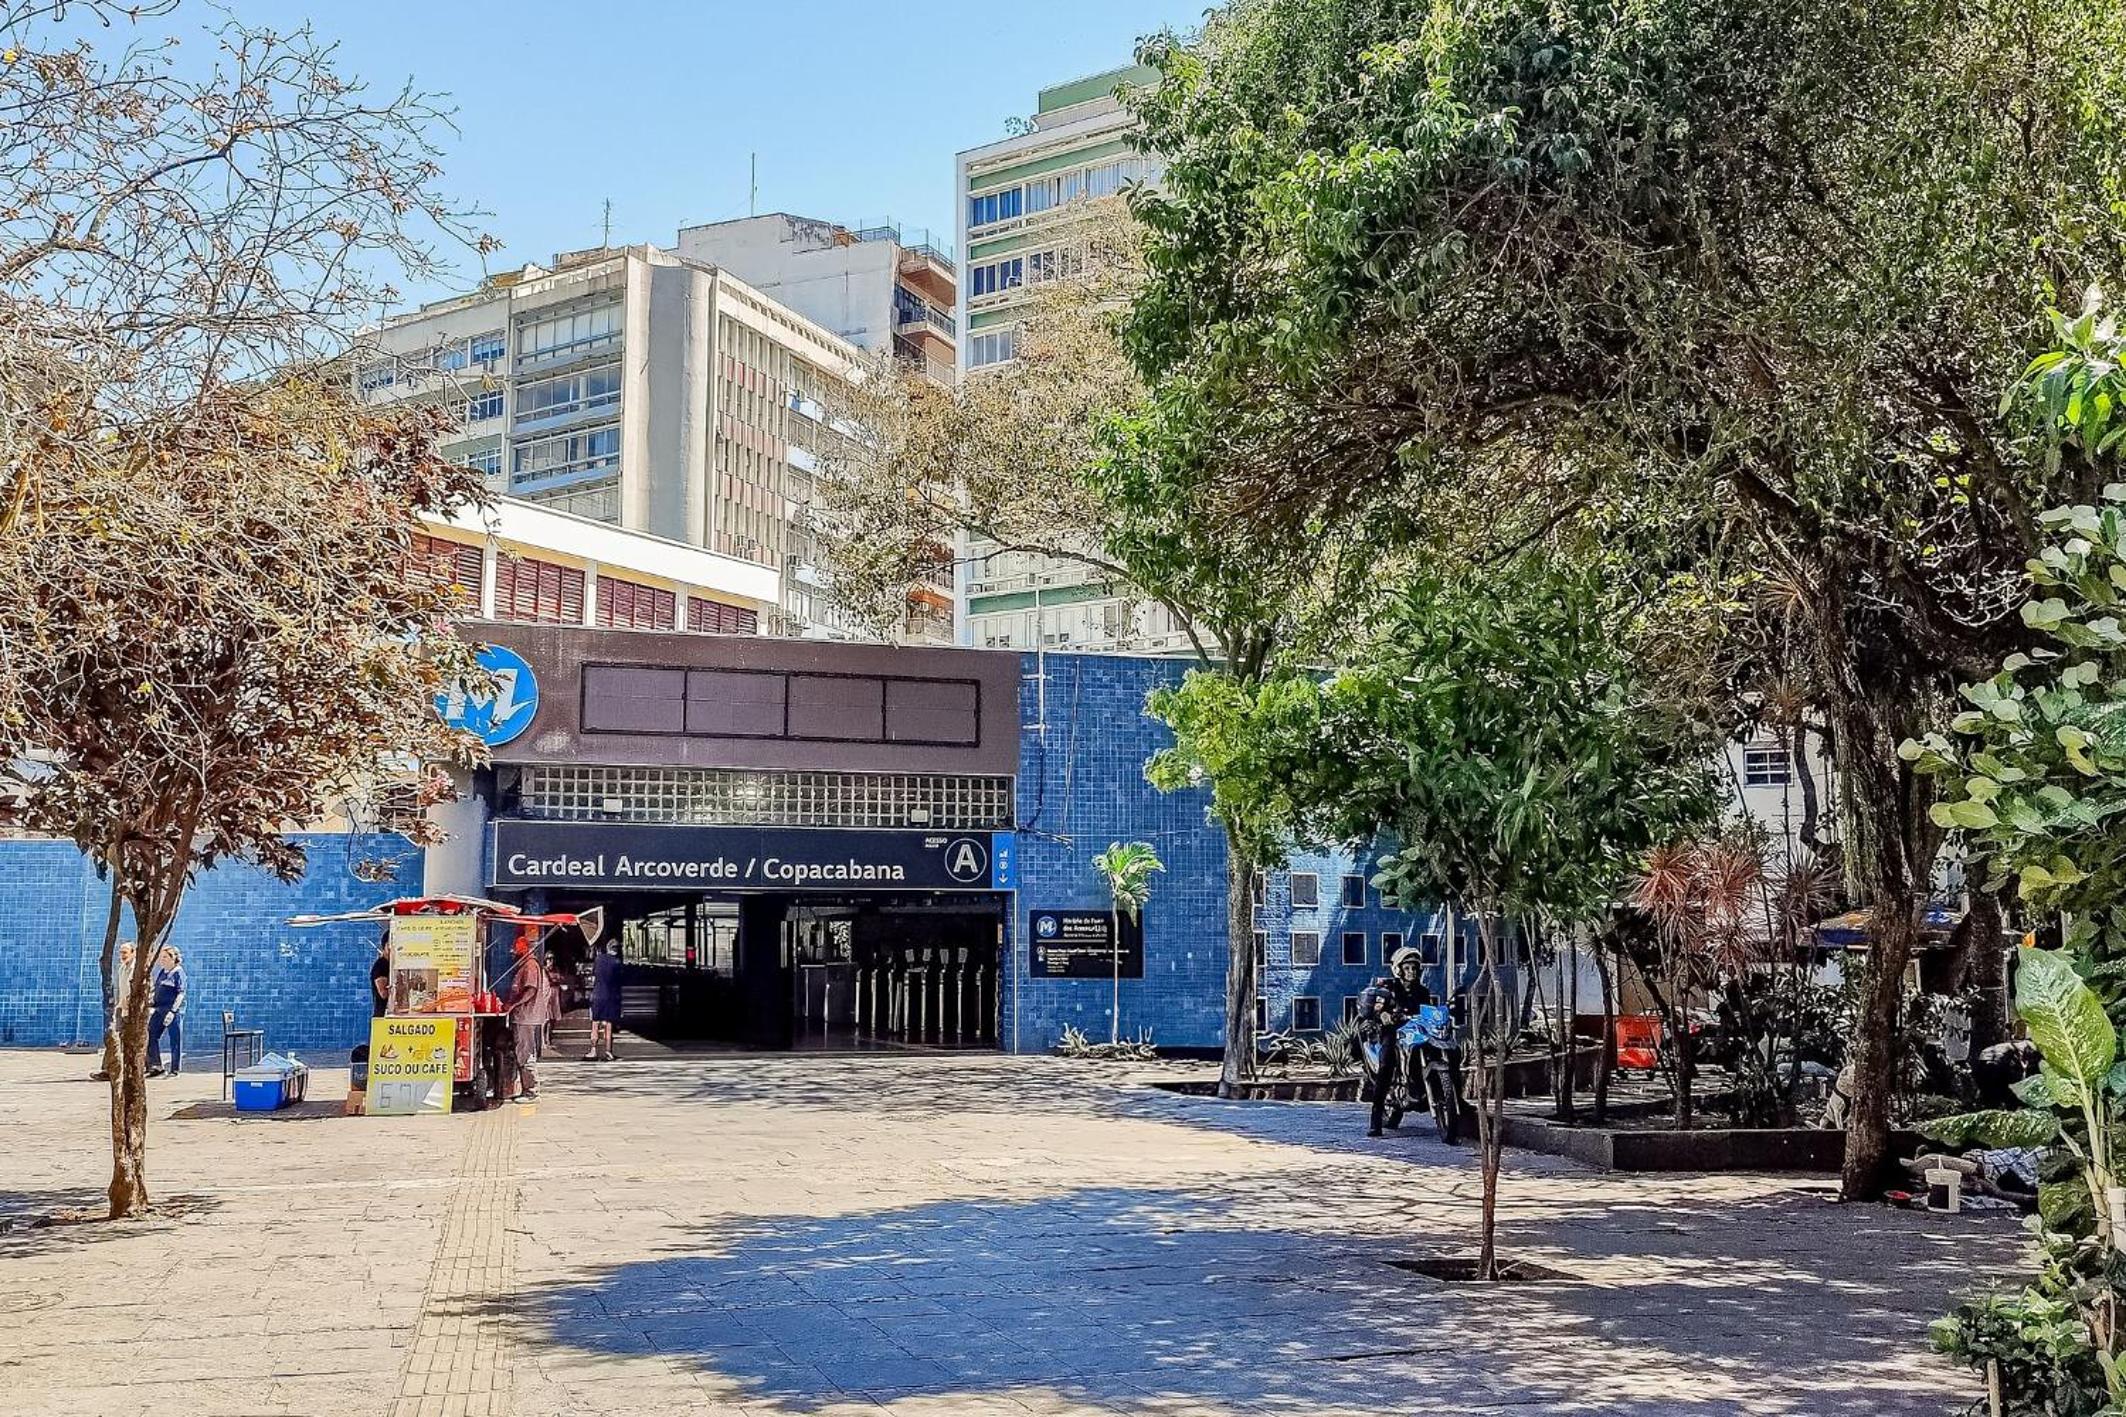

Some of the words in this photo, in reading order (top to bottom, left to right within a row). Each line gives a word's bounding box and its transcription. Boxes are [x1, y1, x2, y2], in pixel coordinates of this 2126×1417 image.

[953, 844, 979, 873] A
[508, 853, 605, 876] Cardeal
[614, 855, 738, 877] Arcoverde
[744, 858, 756, 878] /
[763, 858, 905, 885] Copacabana
[388, 1024, 436, 1035] SALGADO
[374, 1064, 402, 1075] SUCO
[404, 1064, 419, 1075] OU
[421, 1063, 448, 1074] CAFE
